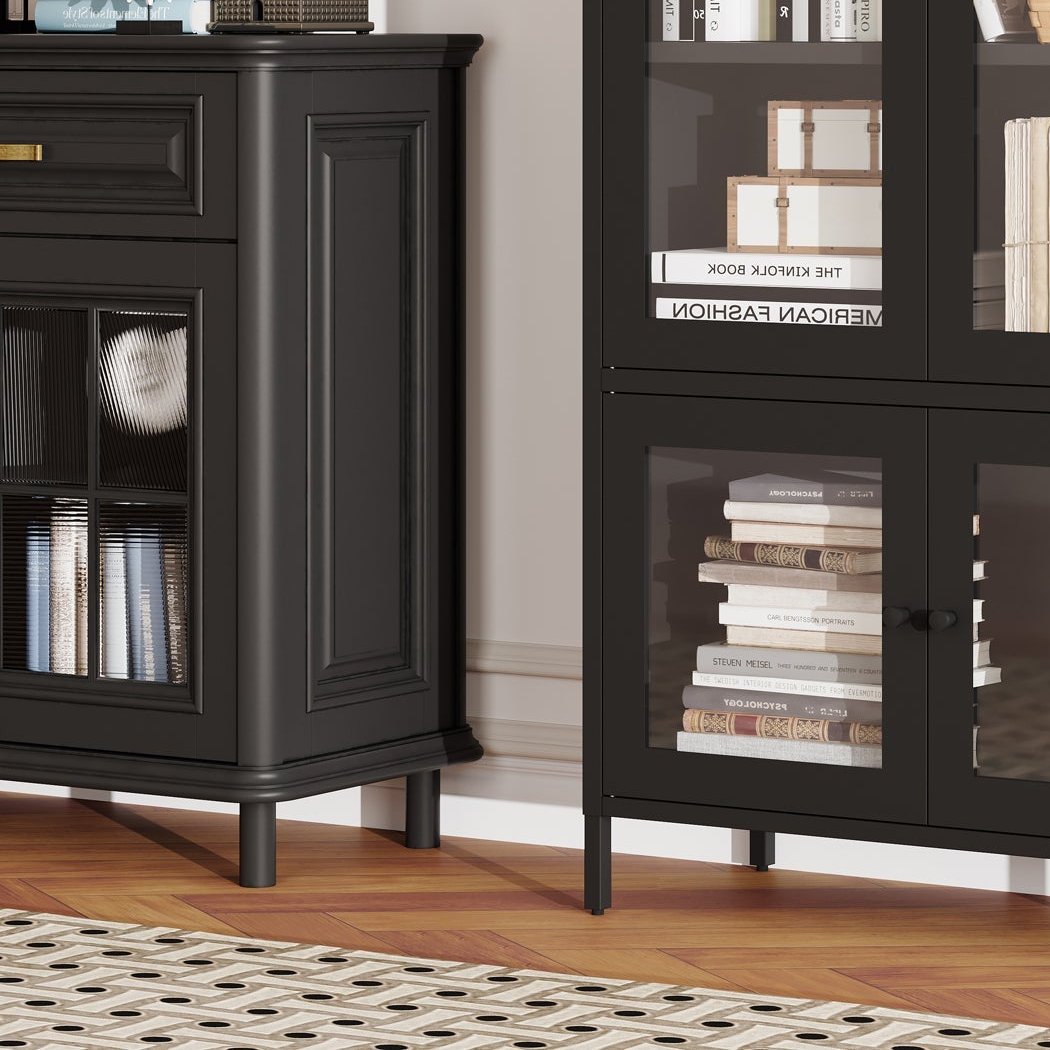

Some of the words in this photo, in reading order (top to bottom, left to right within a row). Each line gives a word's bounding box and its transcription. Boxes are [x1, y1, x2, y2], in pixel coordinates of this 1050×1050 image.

[769, 490, 823, 498] PSYCHOLOGY
[767, 613, 781, 621] CARL
[821, 617, 855, 626] PORTRAITS
[712, 657, 742, 667] STEVEN
[746, 660, 773, 669] MEISEL
[700, 675, 711, 683] THE
[714, 676, 740, 685] SWEDISH
[743, 679, 771, 689] INTERIOR
[775, 682, 797, 690] DESIGN
[829, 686, 845, 695] FROM
